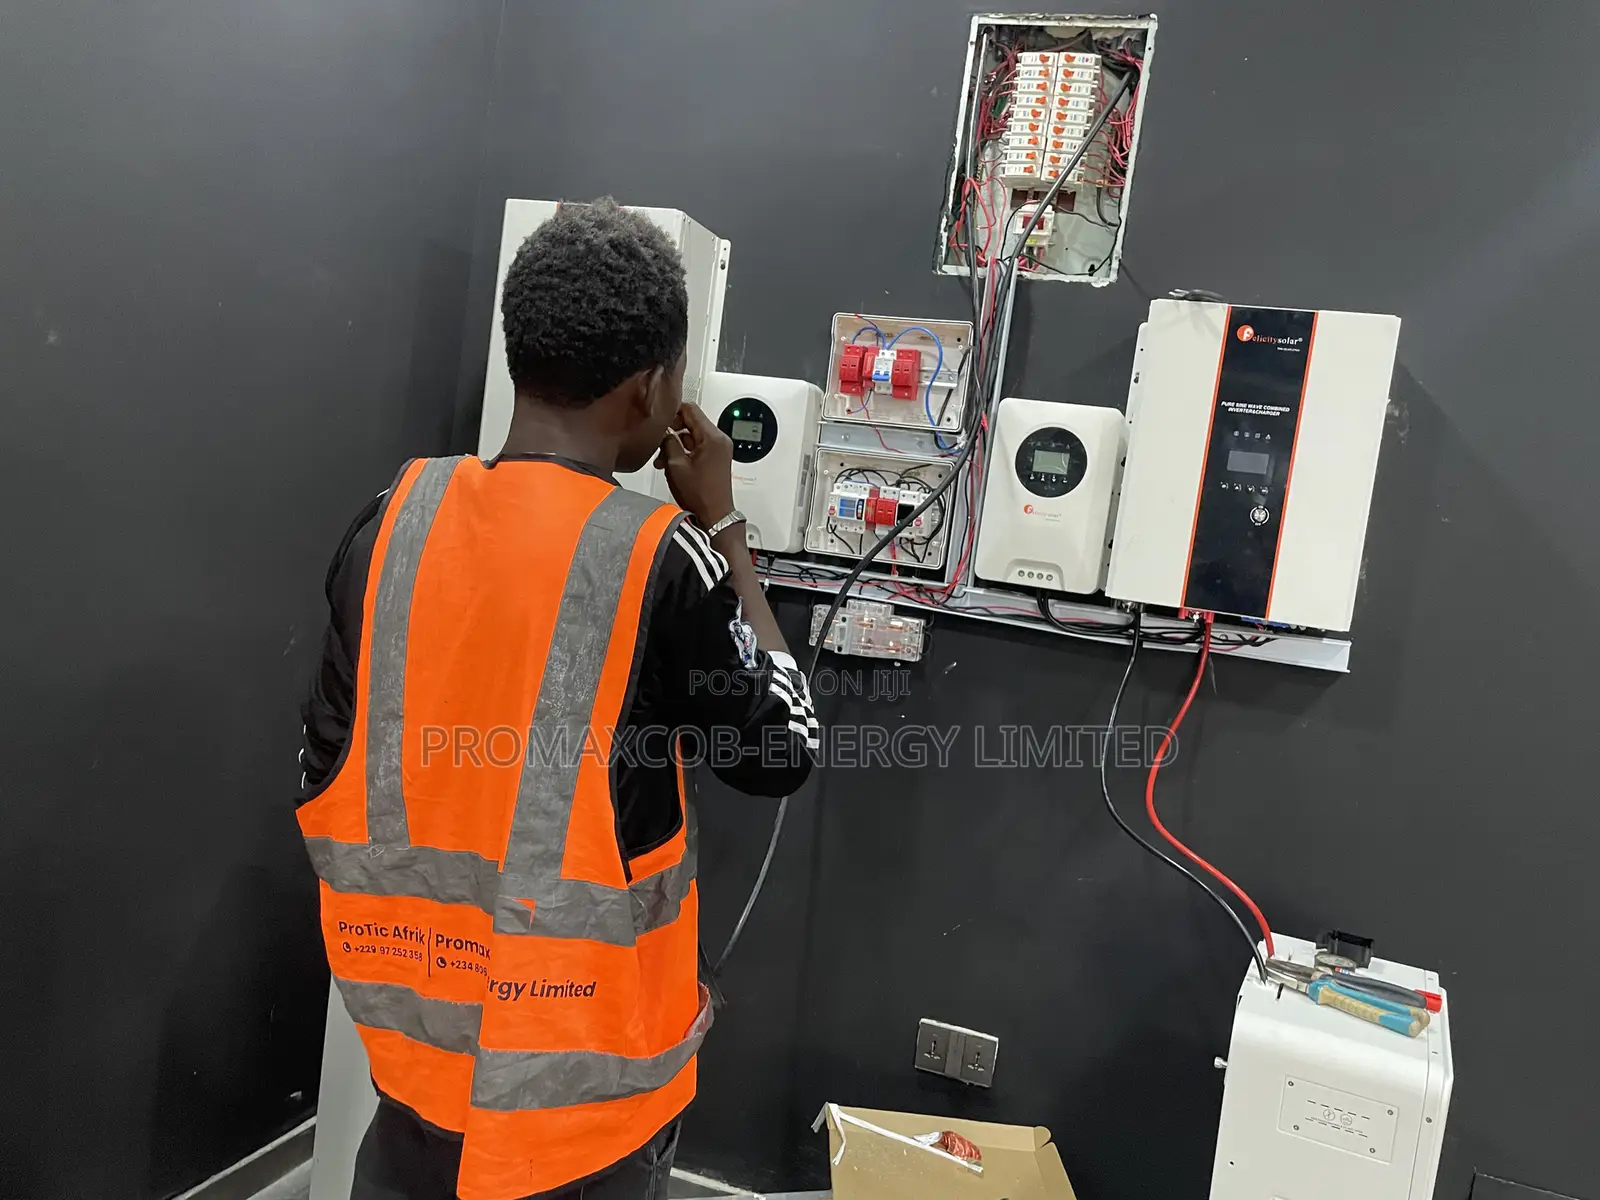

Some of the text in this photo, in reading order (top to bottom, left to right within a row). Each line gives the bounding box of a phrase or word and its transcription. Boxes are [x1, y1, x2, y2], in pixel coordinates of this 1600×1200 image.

[338, 921, 426, 945] ProTic Afrik
[354, 945, 376, 953] +229
[380, 946, 390, 955] 97
[392, 947, 408, 957] 252
[436, 933, 491, 960] Promax
[450, 960, 473, 971] +234
[530, 978, 597, 998] Limited
